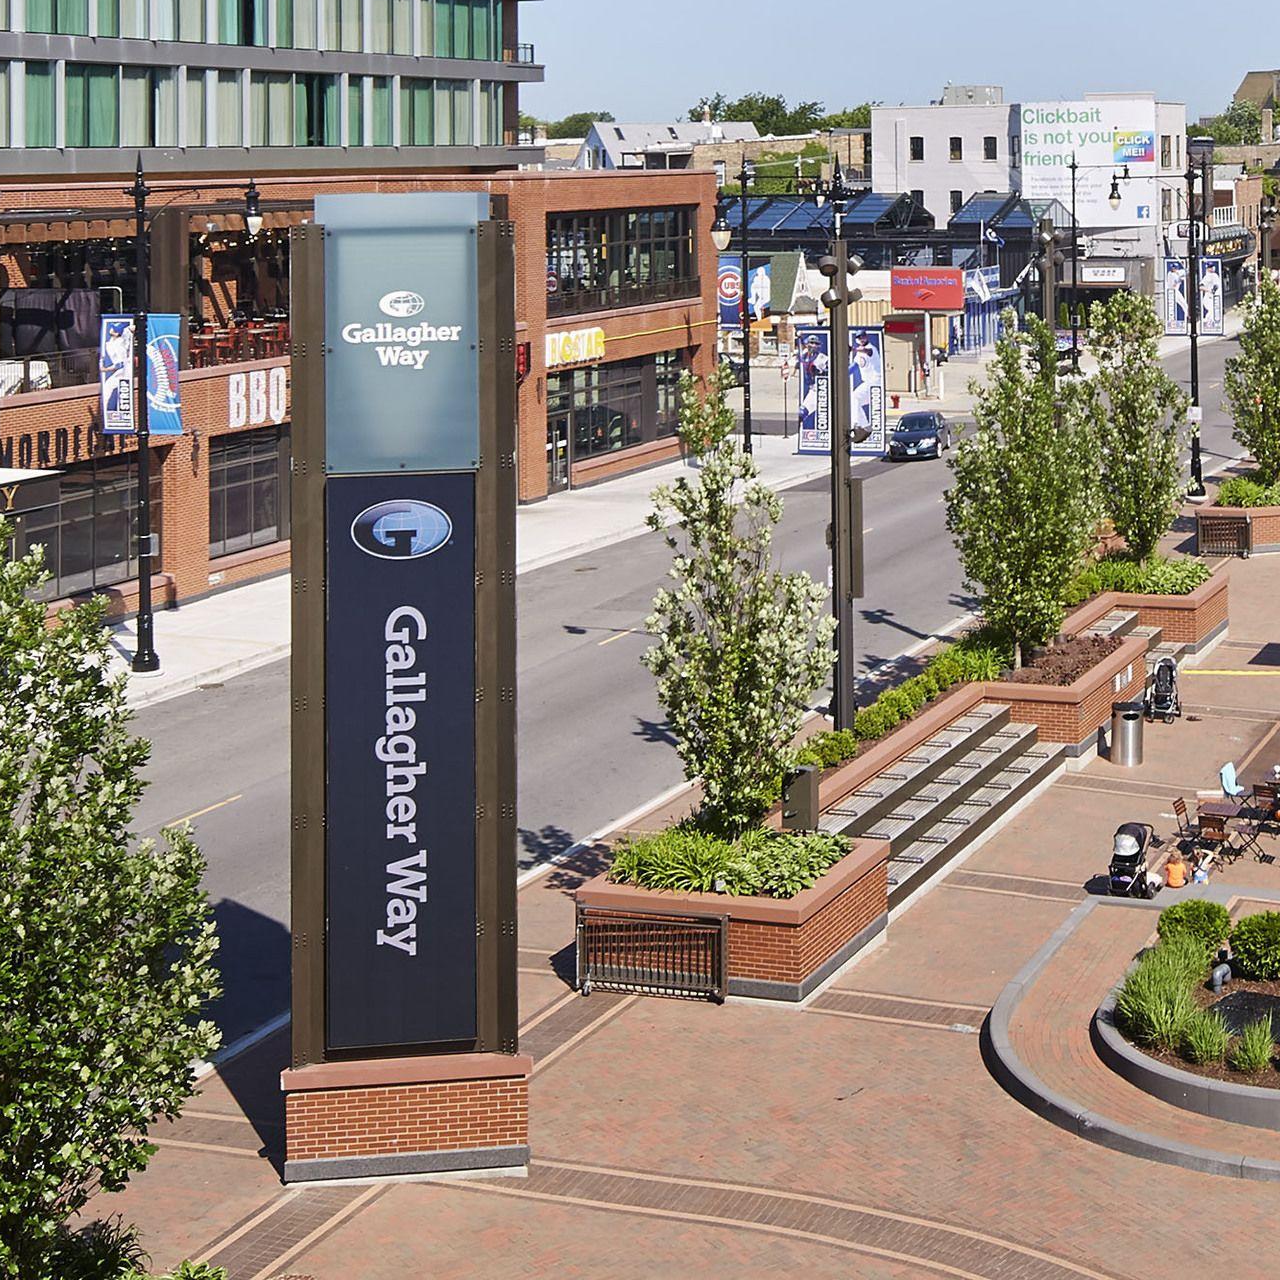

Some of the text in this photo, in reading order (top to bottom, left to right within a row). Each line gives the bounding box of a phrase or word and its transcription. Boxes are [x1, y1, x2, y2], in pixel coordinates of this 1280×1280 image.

[1022, 108, 1102, 124] Clickbait
[1024, 130, 1038, 145] is
[1044, 129, 1073, 145] not
[1117, 135, 1150, 145] CLICK
[1123, 147, 1145, 157] ME!!
[342, 322, 462, 346] Gallagher
[376, 346, 429, 370] Way
[228, 367, 287, 429] BBQ
[818, 378, 828, 430] CONTRERAS
[871, 387, 881, 430] CHATWOOD
[375, 606, 427, 843] Gallagher
[376, 849, 428, 956] Way
